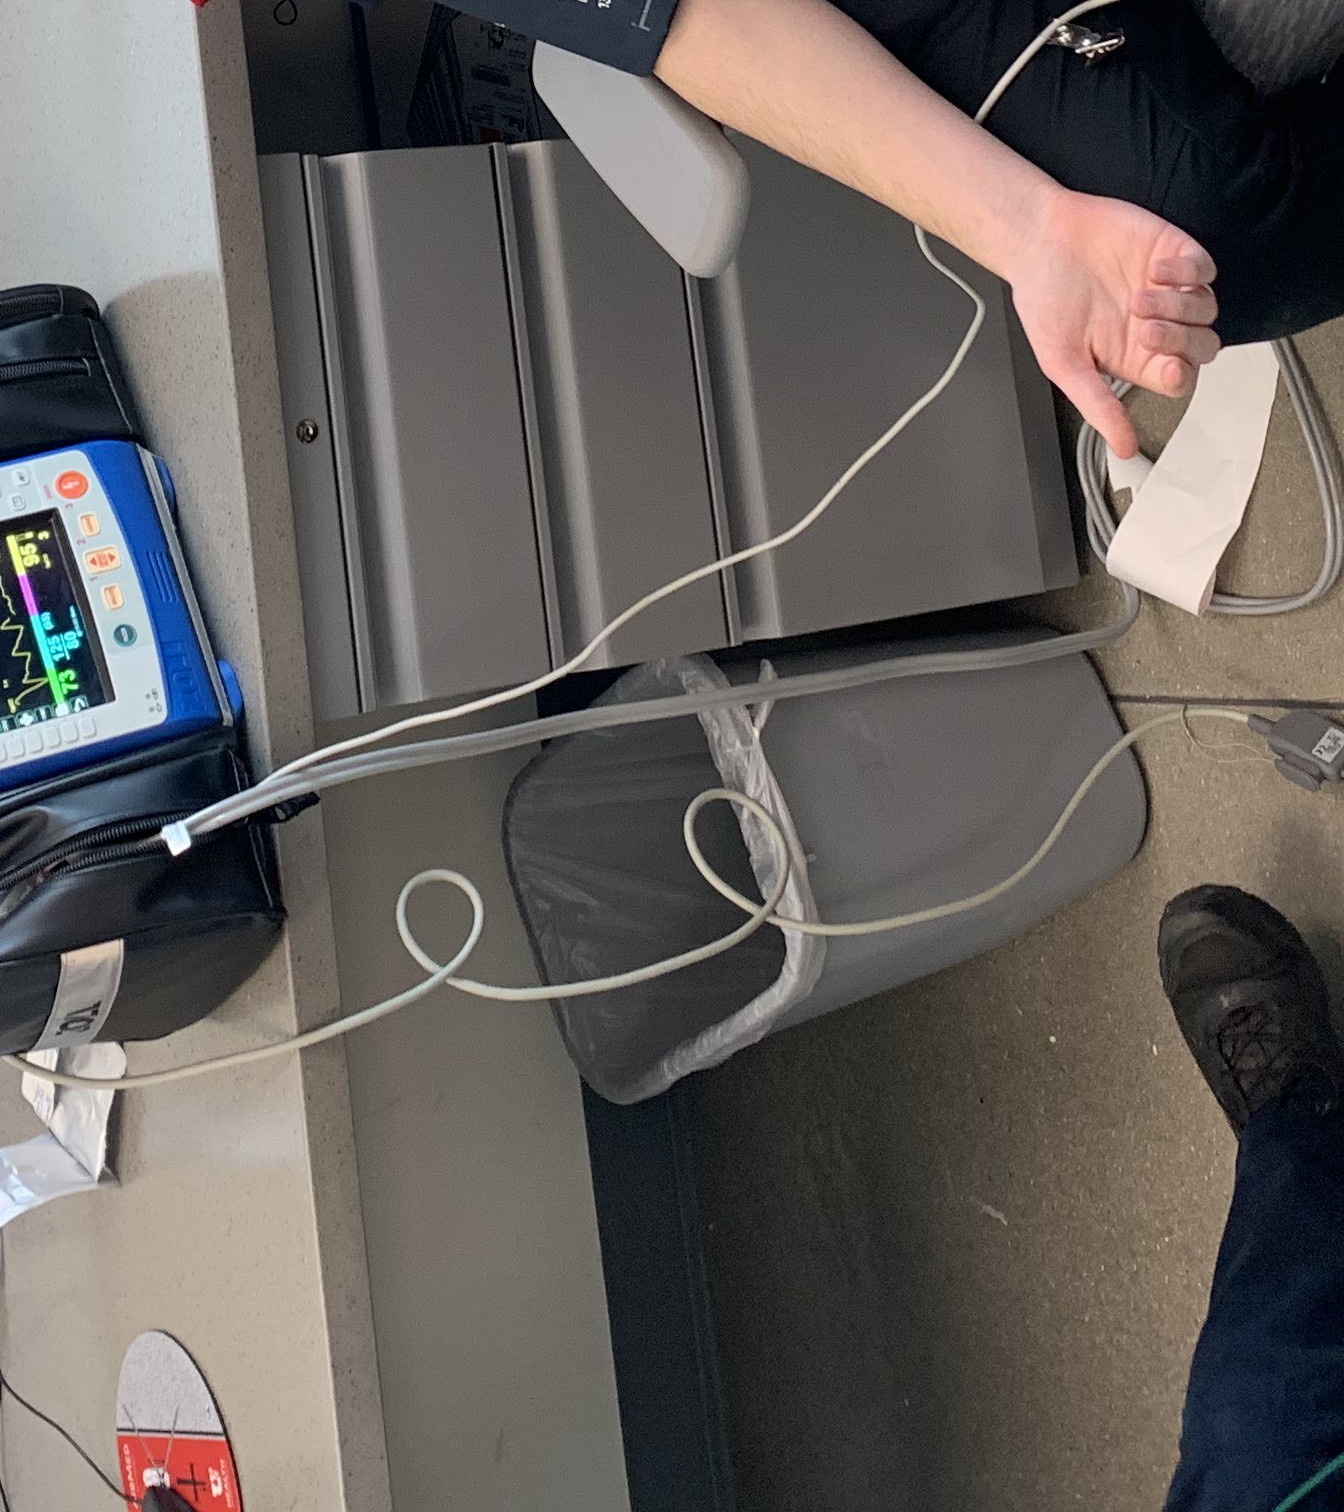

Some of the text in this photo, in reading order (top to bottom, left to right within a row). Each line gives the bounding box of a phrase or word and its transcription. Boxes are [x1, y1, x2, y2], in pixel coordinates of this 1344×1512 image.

[38, 530, 51, 541] 3
[18, 542, 41, 568] 95
[46, 635, 65, 662] 125
[63, 630, 80, 651] 80
[58, 668, 80, 696] 73
